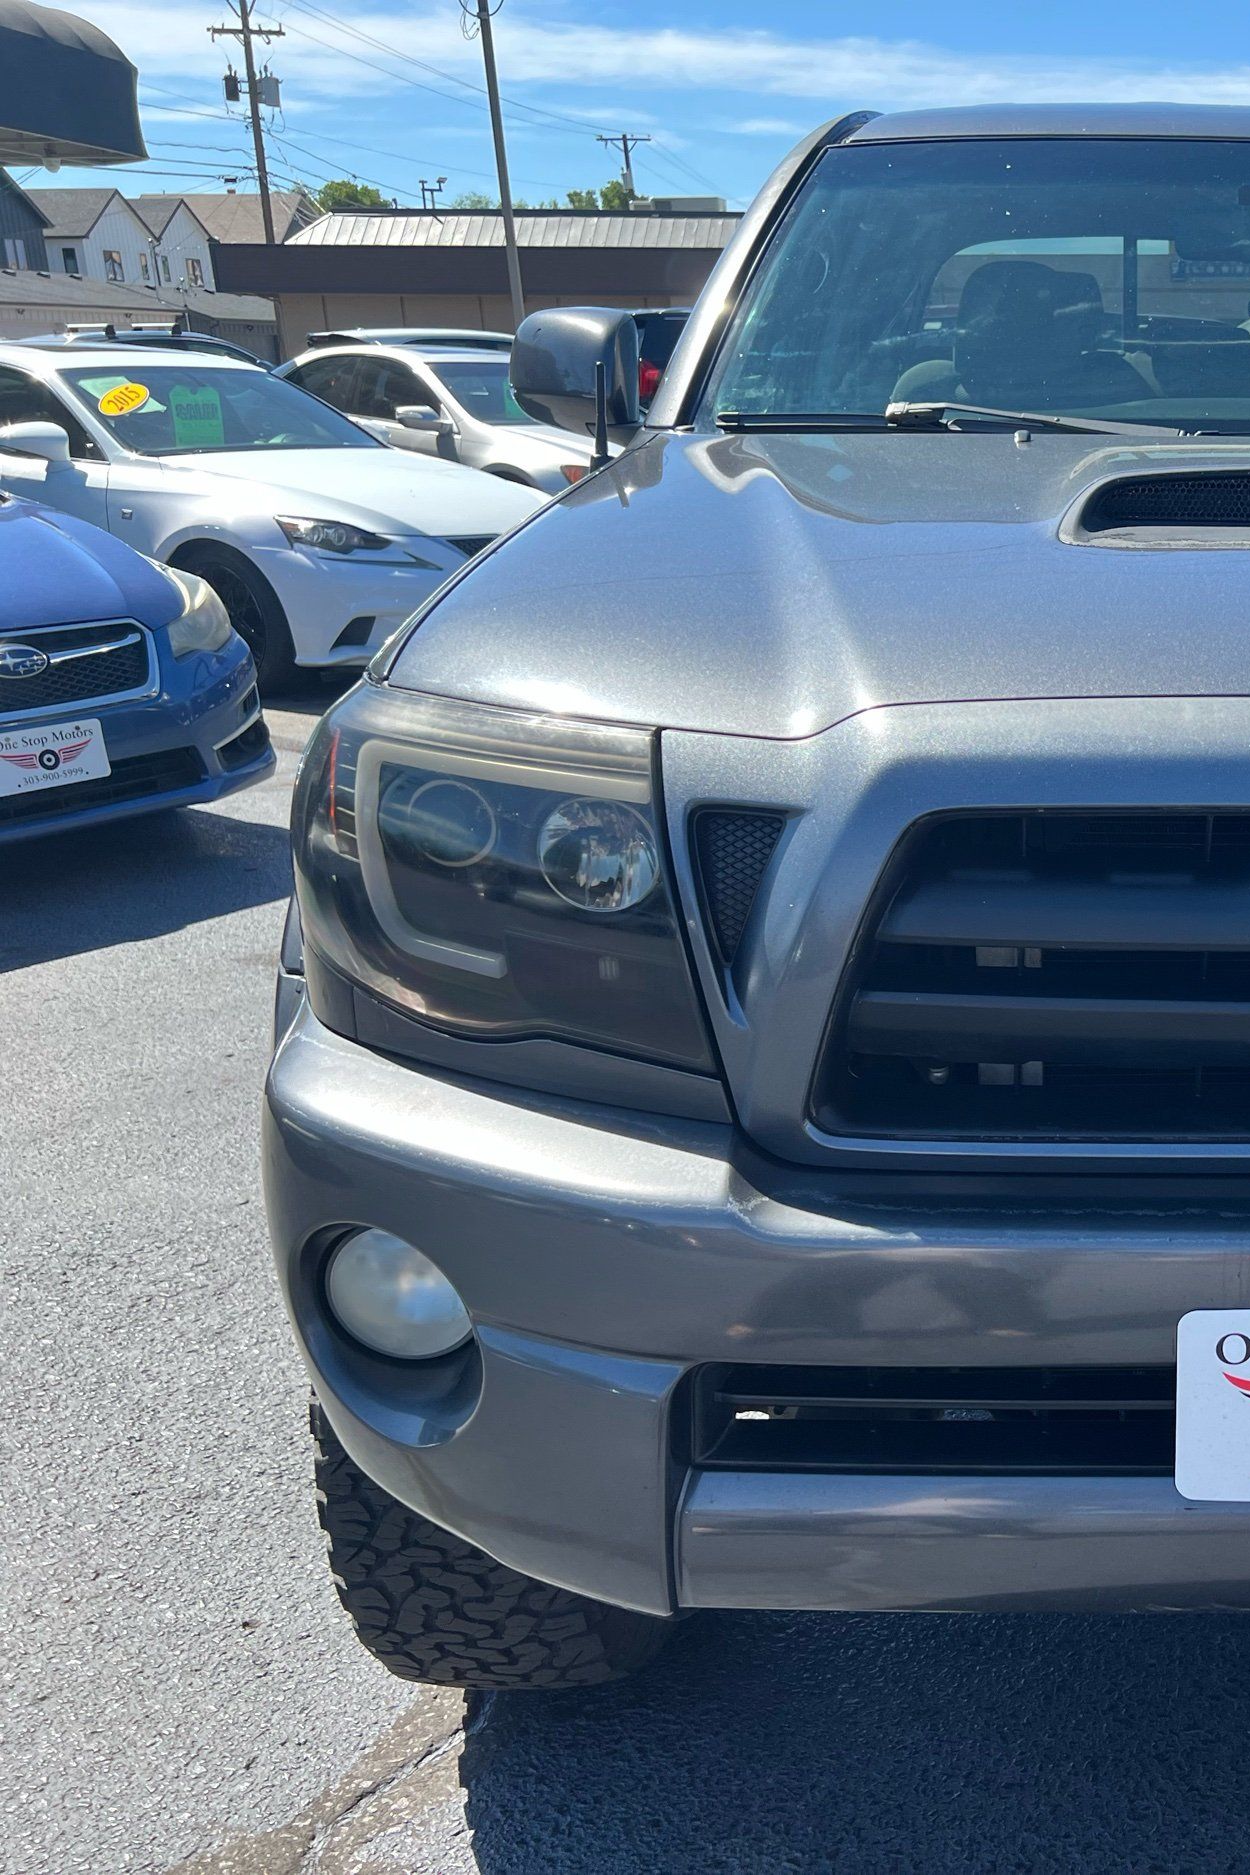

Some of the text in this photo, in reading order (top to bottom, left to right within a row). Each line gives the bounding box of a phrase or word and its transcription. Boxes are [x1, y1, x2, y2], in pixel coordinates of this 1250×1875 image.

[107, 386, 141, 412] 2015
[21, 735, 48, 747] Stop
[52, 728, 94, 743] Motors
[23, 766, 84, 786] 303-900-5999
